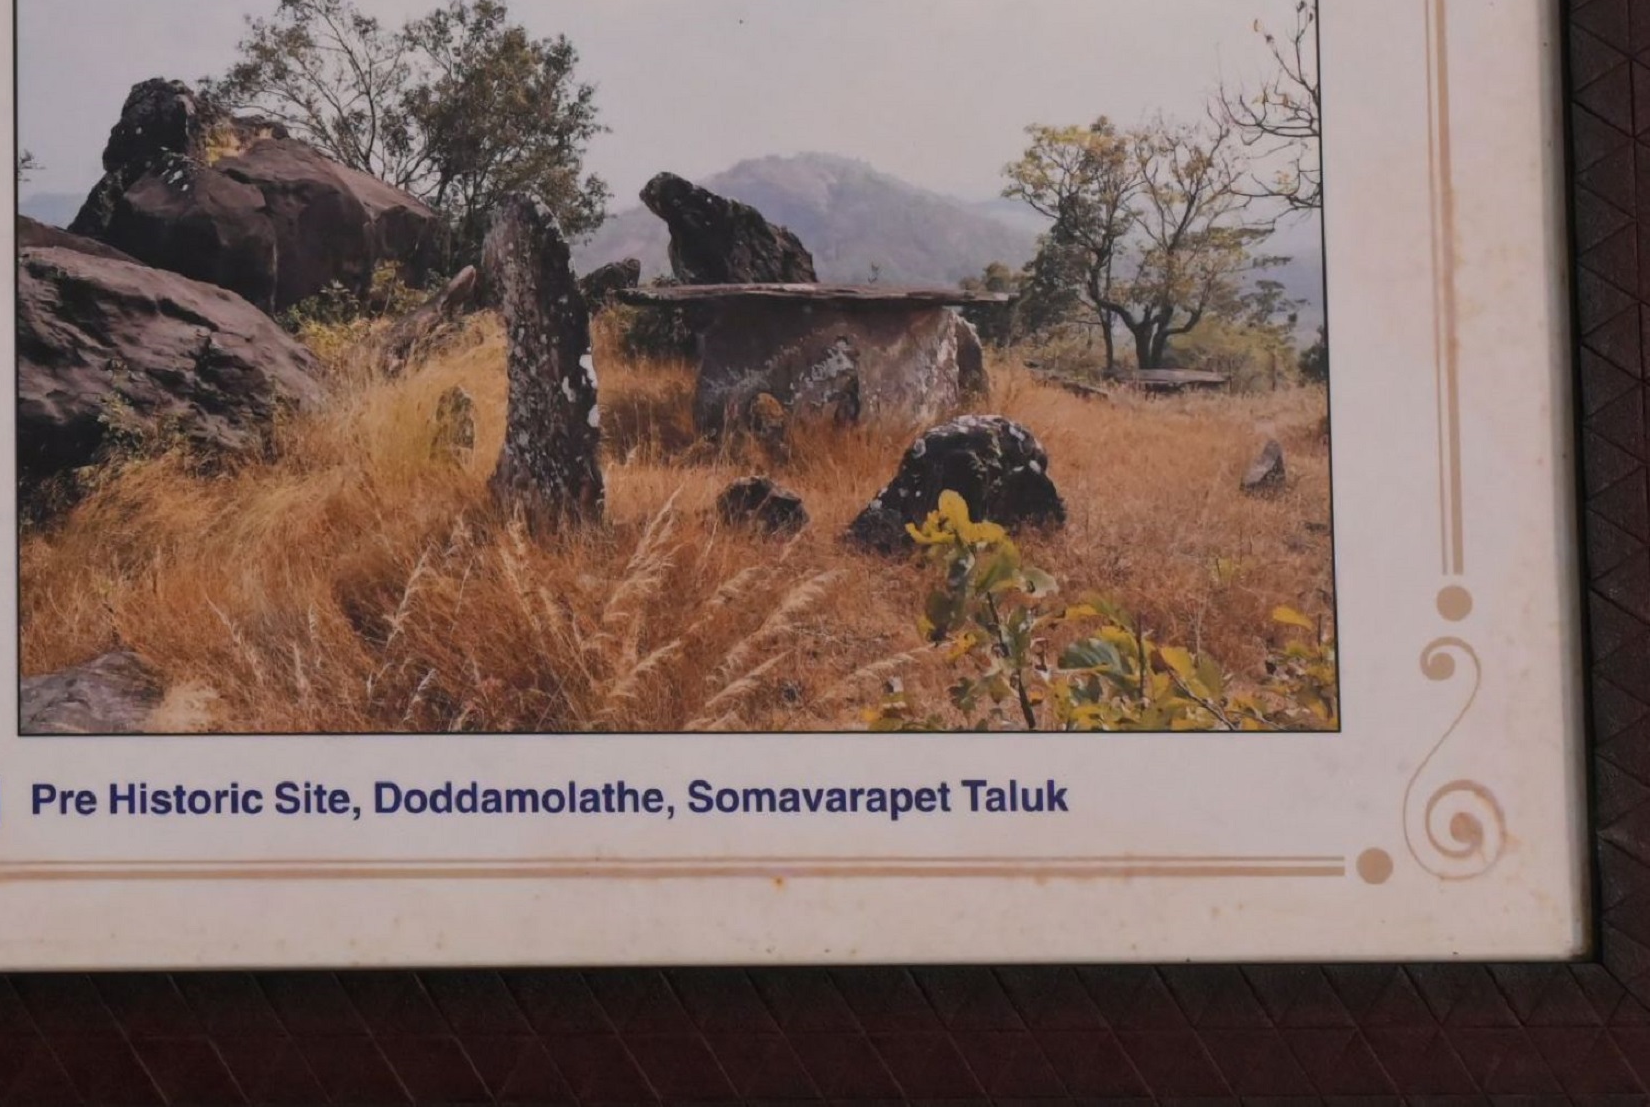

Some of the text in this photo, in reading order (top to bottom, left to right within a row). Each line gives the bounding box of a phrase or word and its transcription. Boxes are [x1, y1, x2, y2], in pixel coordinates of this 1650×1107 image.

[31, 779, 1069, 822] Pre Historic Site, Doddamolathe, Somavarapet Taluk
